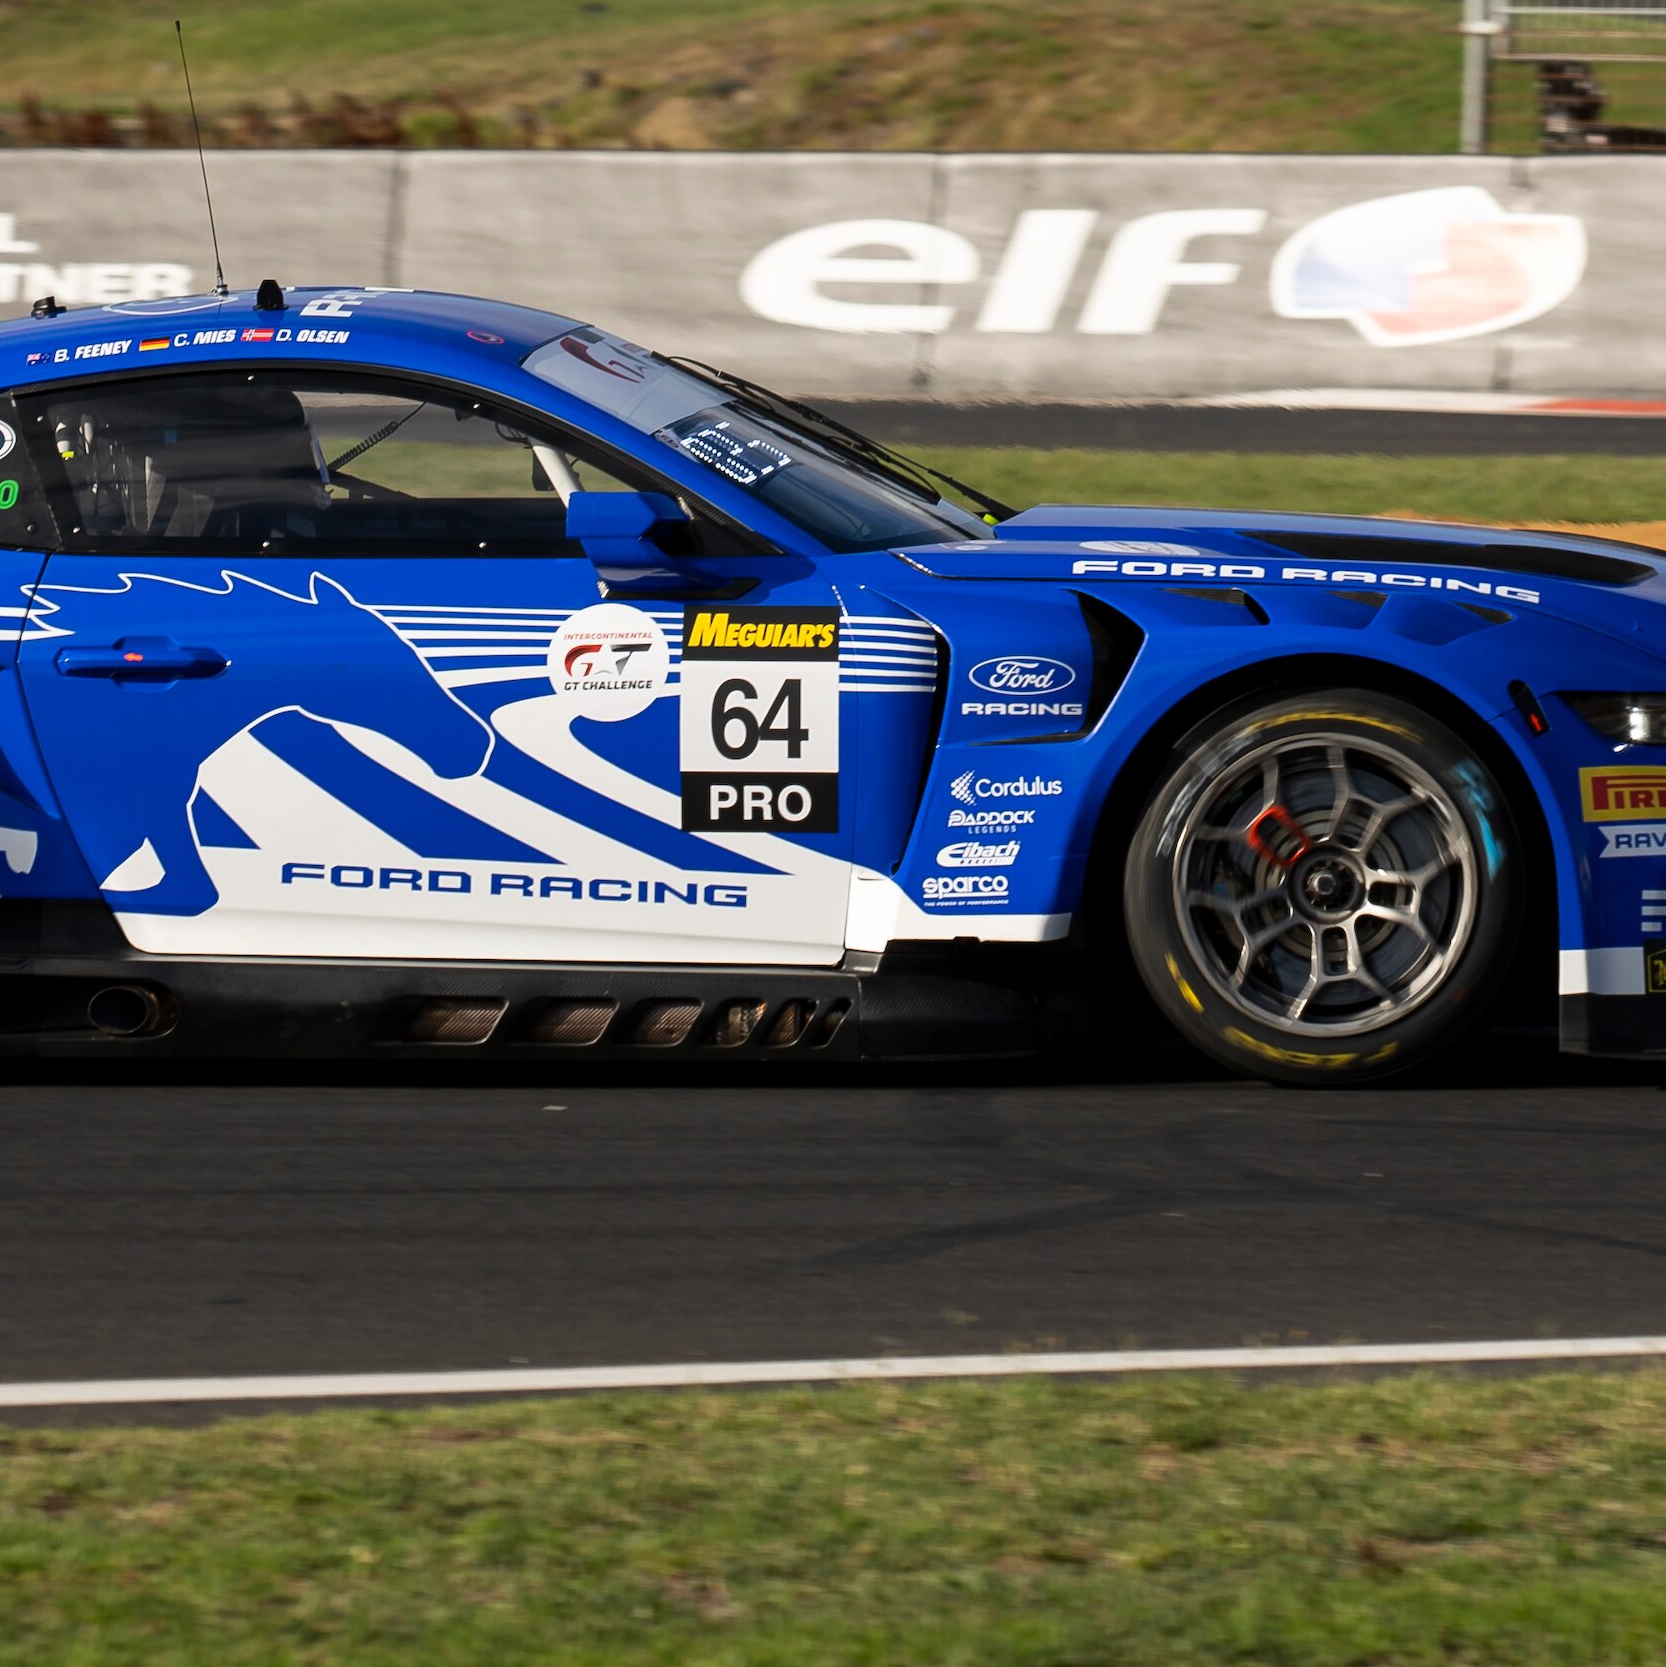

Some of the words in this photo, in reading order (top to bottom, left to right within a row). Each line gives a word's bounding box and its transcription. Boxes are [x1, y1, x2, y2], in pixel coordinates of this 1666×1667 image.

[739, 208, 1267, 334] elf
[173, 333, 190, 348] C.
[192, 329, 237, 346] MIES
[276, 328, 293, 343] D.
[296, 328, 349, 344] OLSEN
[54, 348, 71, 363] B.
[74, 340, 132, 361] FEENEY
[1072, 560, 1265, 579] FORD
[1282, 567, 1540, 604] RACING
[564, 632, 653, 641] INTERCONTINENTAL
[564, 680, 580, 690] GT
[583, 680, 653, 690] CHALLENGE
[988, 660, 1053, 690] Ford
[711, 677, 810, 760] 64
[961, 702, 1083, 716] RACING
[974, 776, 1063, 798] Cordulus
[709, 784, 812, 822] PRO
[948, 809, 1036, 828] PADDOCK
[968, 824, 1017, 835] LEGENDS
[936, 840, 1022, 868] Eibach
[280, 862, 472, 893] FORD
[490, 872, 748, 909] RACING
[921, 875, 1009, 900] sparco
